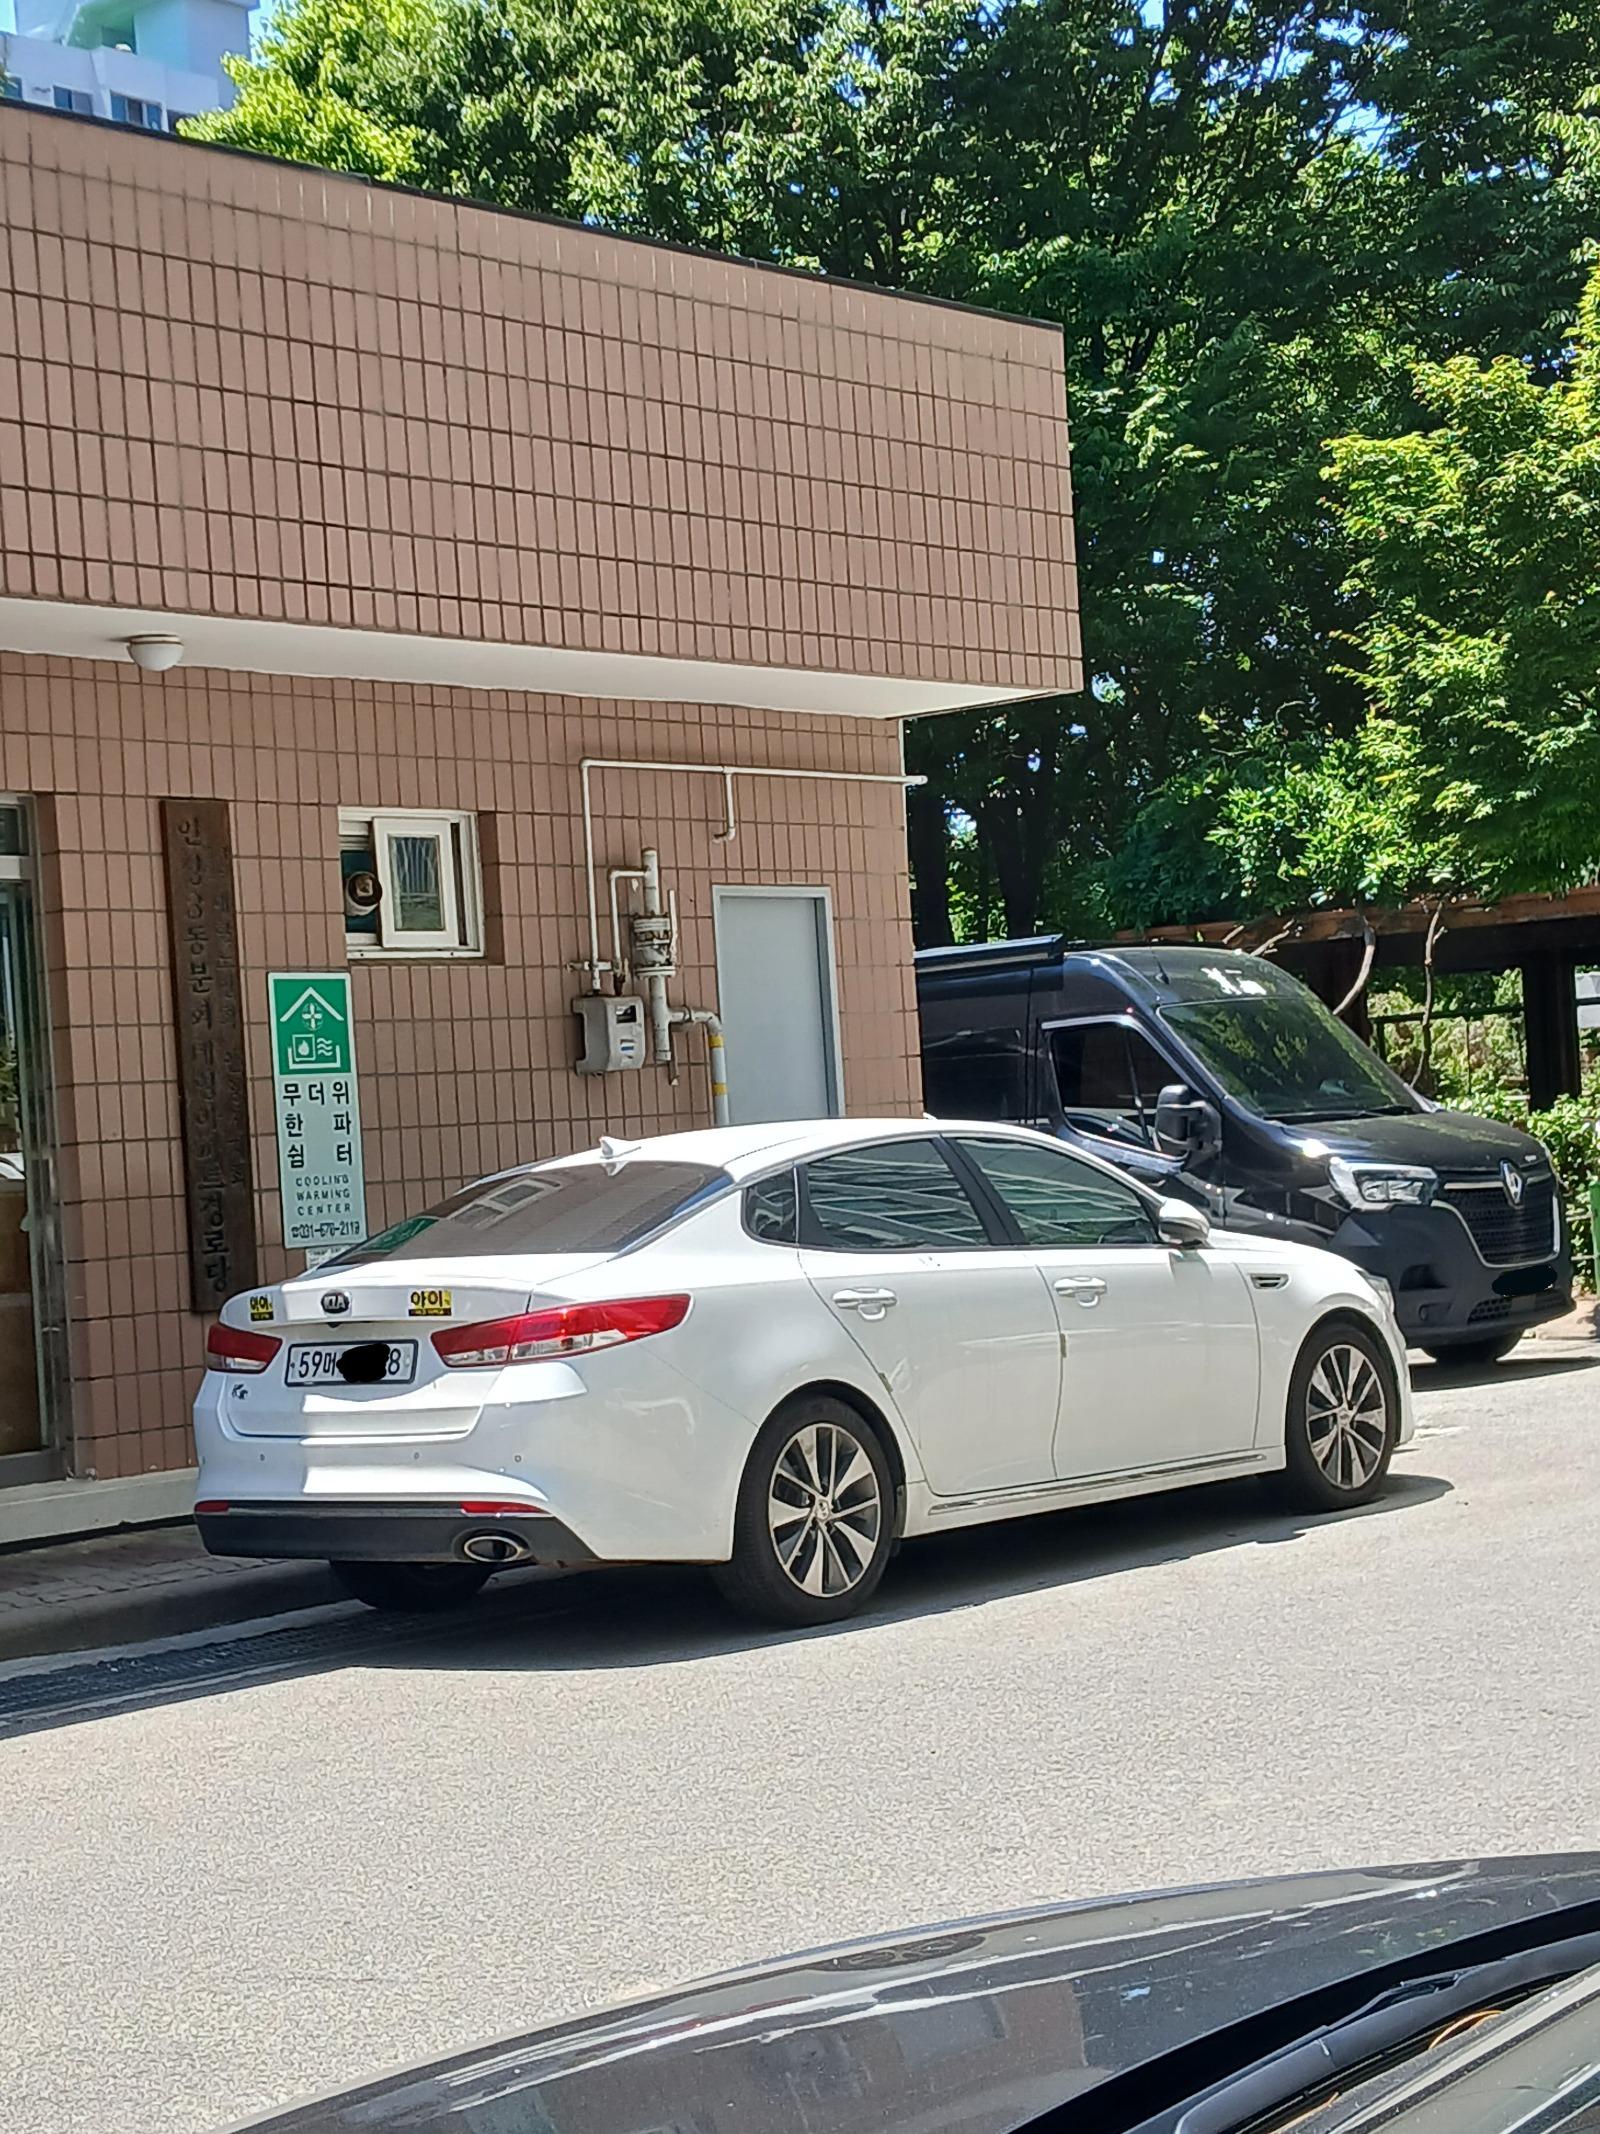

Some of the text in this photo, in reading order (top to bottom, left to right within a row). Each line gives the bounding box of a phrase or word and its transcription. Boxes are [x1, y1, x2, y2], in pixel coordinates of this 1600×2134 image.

[282, 1080, 350, 1107] 무더위
[295, 1174, 350, 1187] COOLING
[296, 1188, 351, 1201] WARMING
[297, 1203, 352, 1216] CENTER
[323, 1295, 346, 1310] KIA
